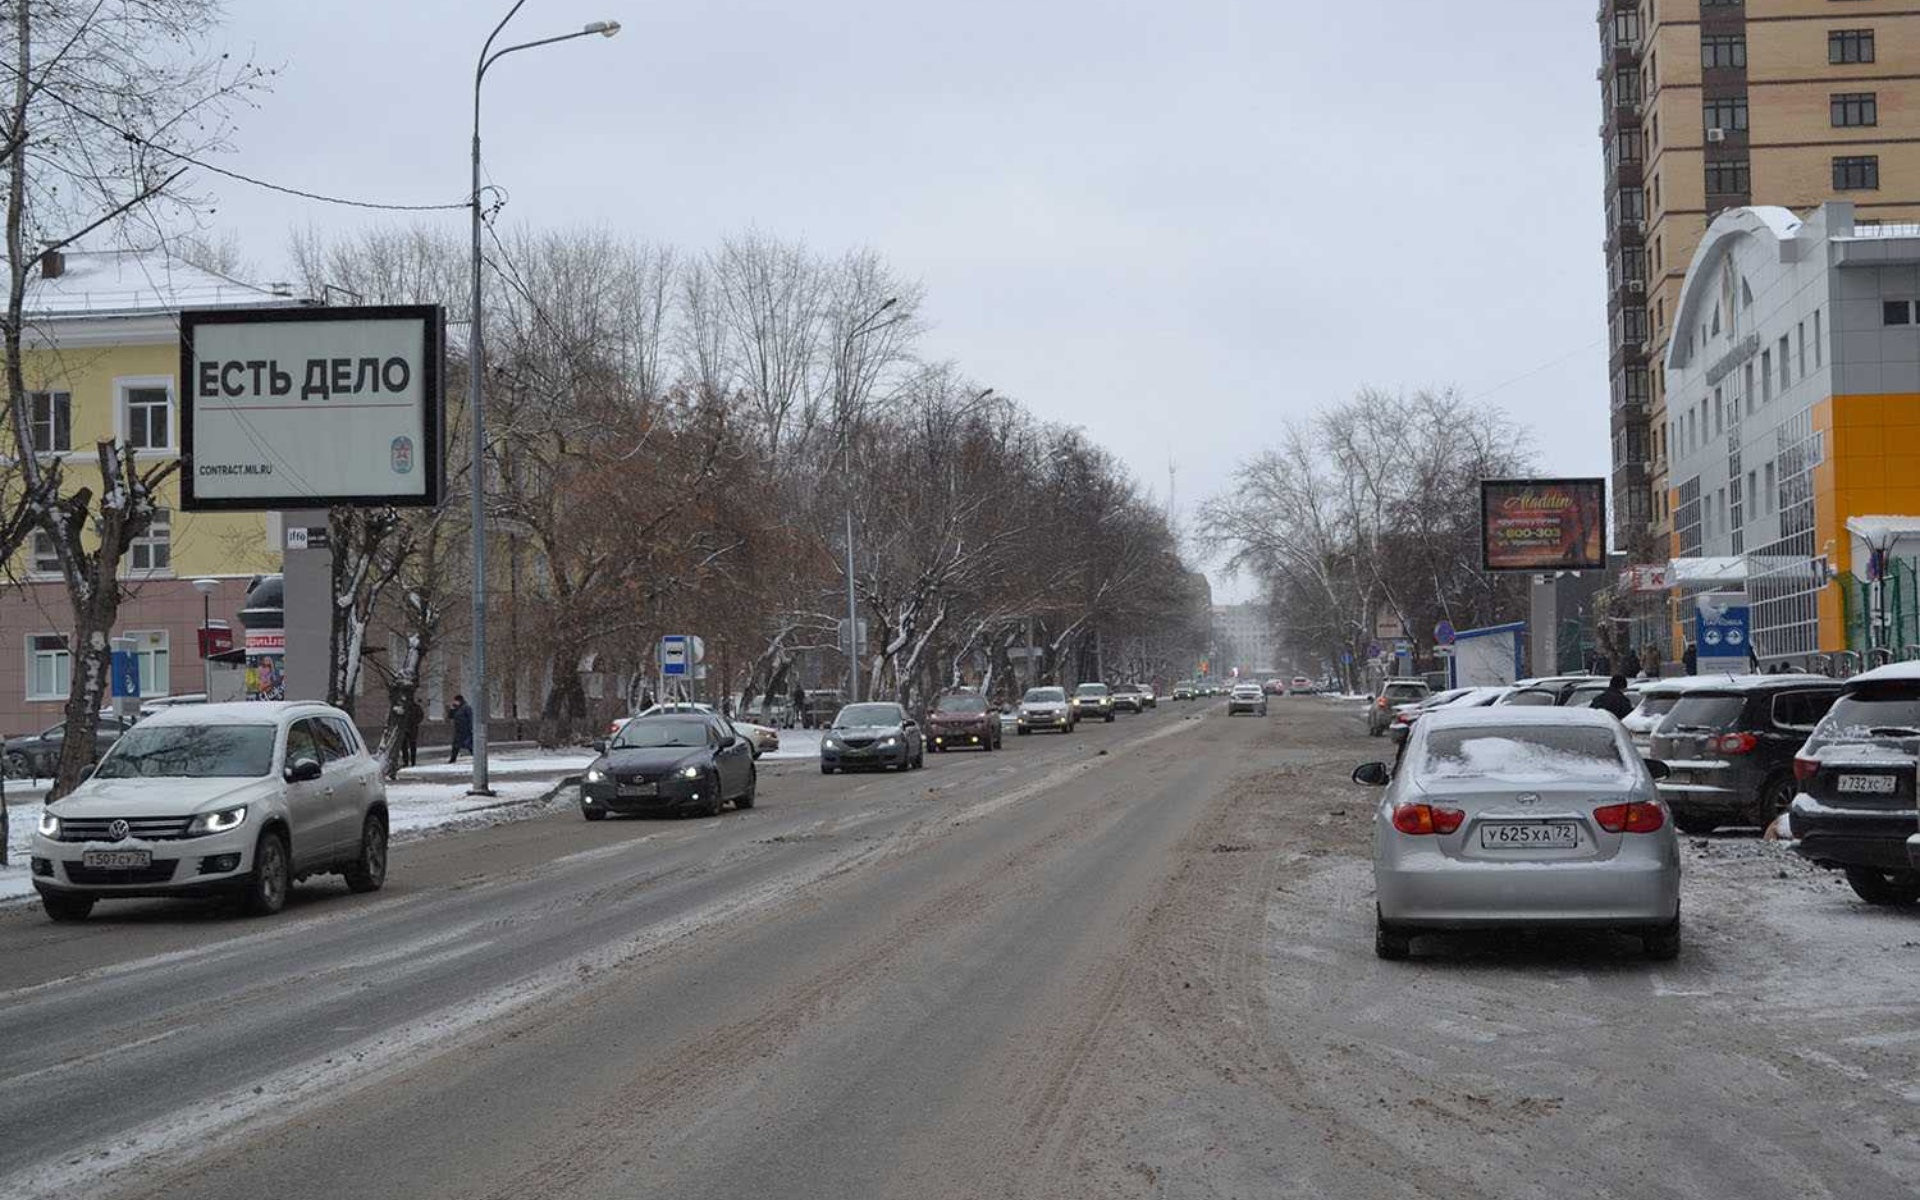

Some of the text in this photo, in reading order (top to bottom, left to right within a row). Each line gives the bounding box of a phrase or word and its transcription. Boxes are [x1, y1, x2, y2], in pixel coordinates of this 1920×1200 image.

[200, 356, 410, 401] ЕСТЬ ДЕЛО
[200, 464, 272, 476] CONTRACT.MIL.RU
